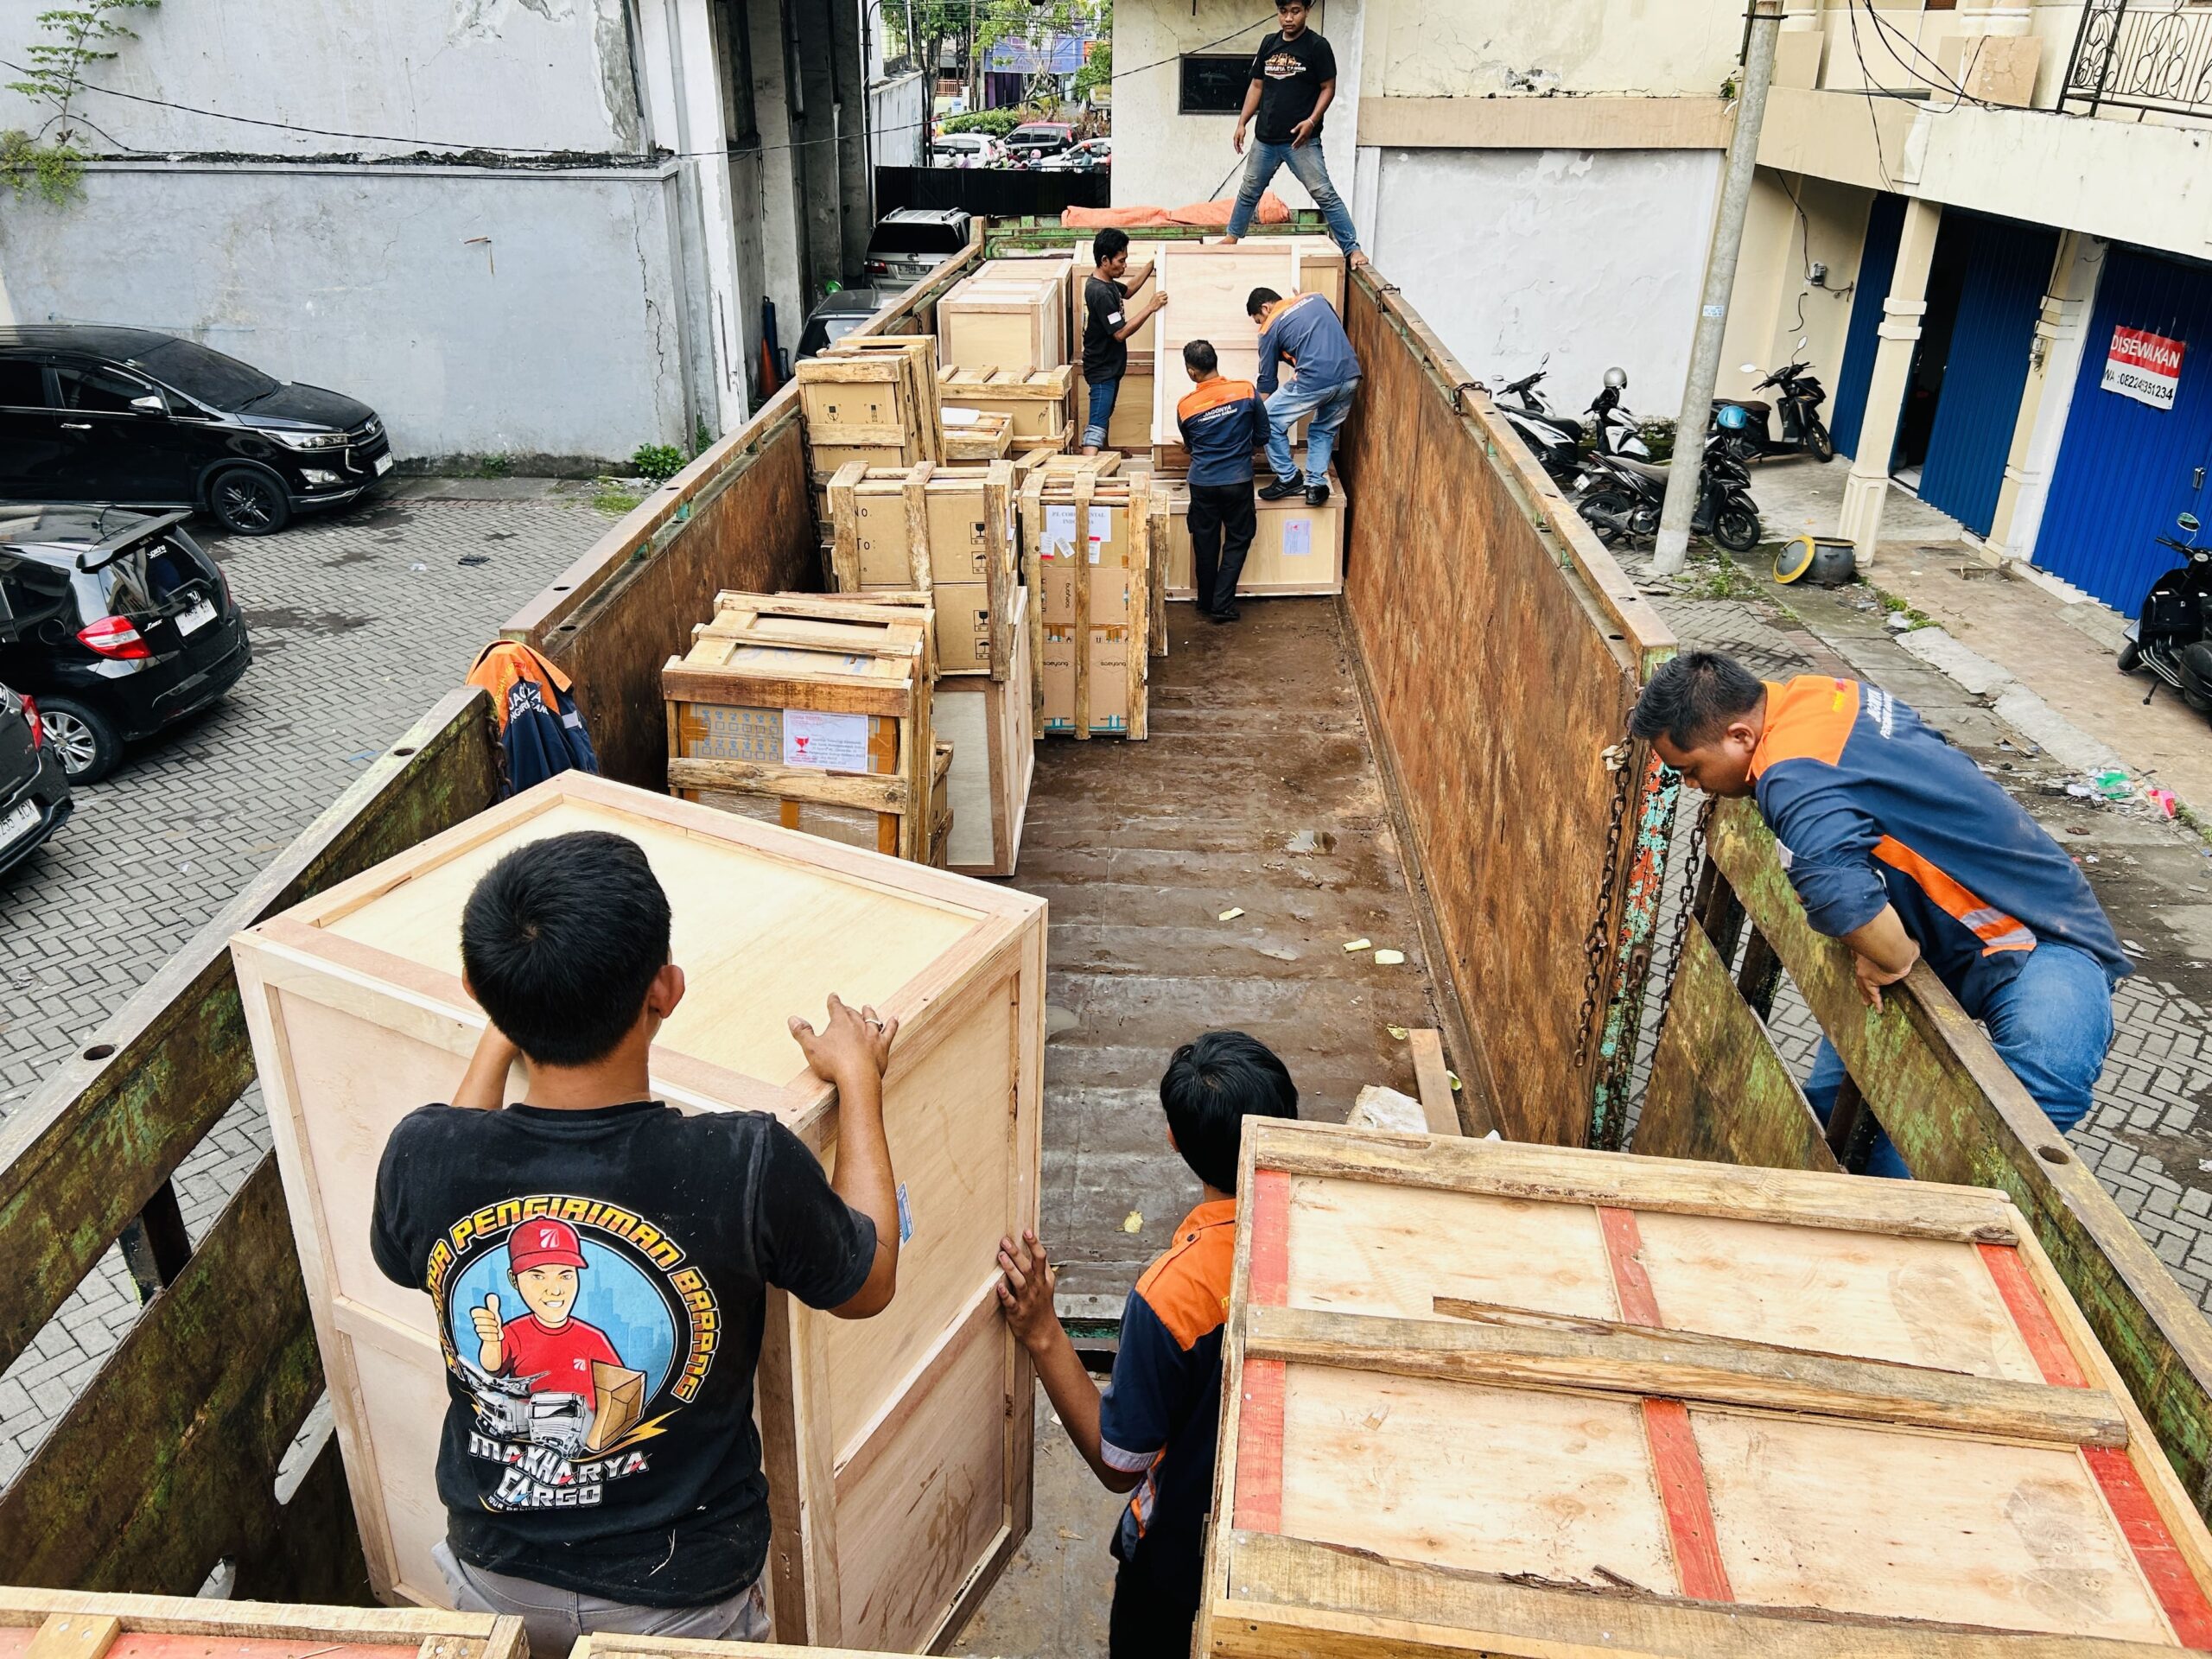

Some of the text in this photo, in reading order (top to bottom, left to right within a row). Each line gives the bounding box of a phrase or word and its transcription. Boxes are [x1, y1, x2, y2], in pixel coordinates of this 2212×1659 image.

[2110, 334, 2181, 369] DISEWAKAN
[17, 800, 35, 820] ACX
[452, 1196, 684, 1270] PENGIRIMAN
[668, 1268, 721, 1402] BARANG
[468, 1430, 652, 1486] MAKHARYA
[487, 1496, 504, 1510] YOUR
[494, 1467, 602, 1508] CARGO
